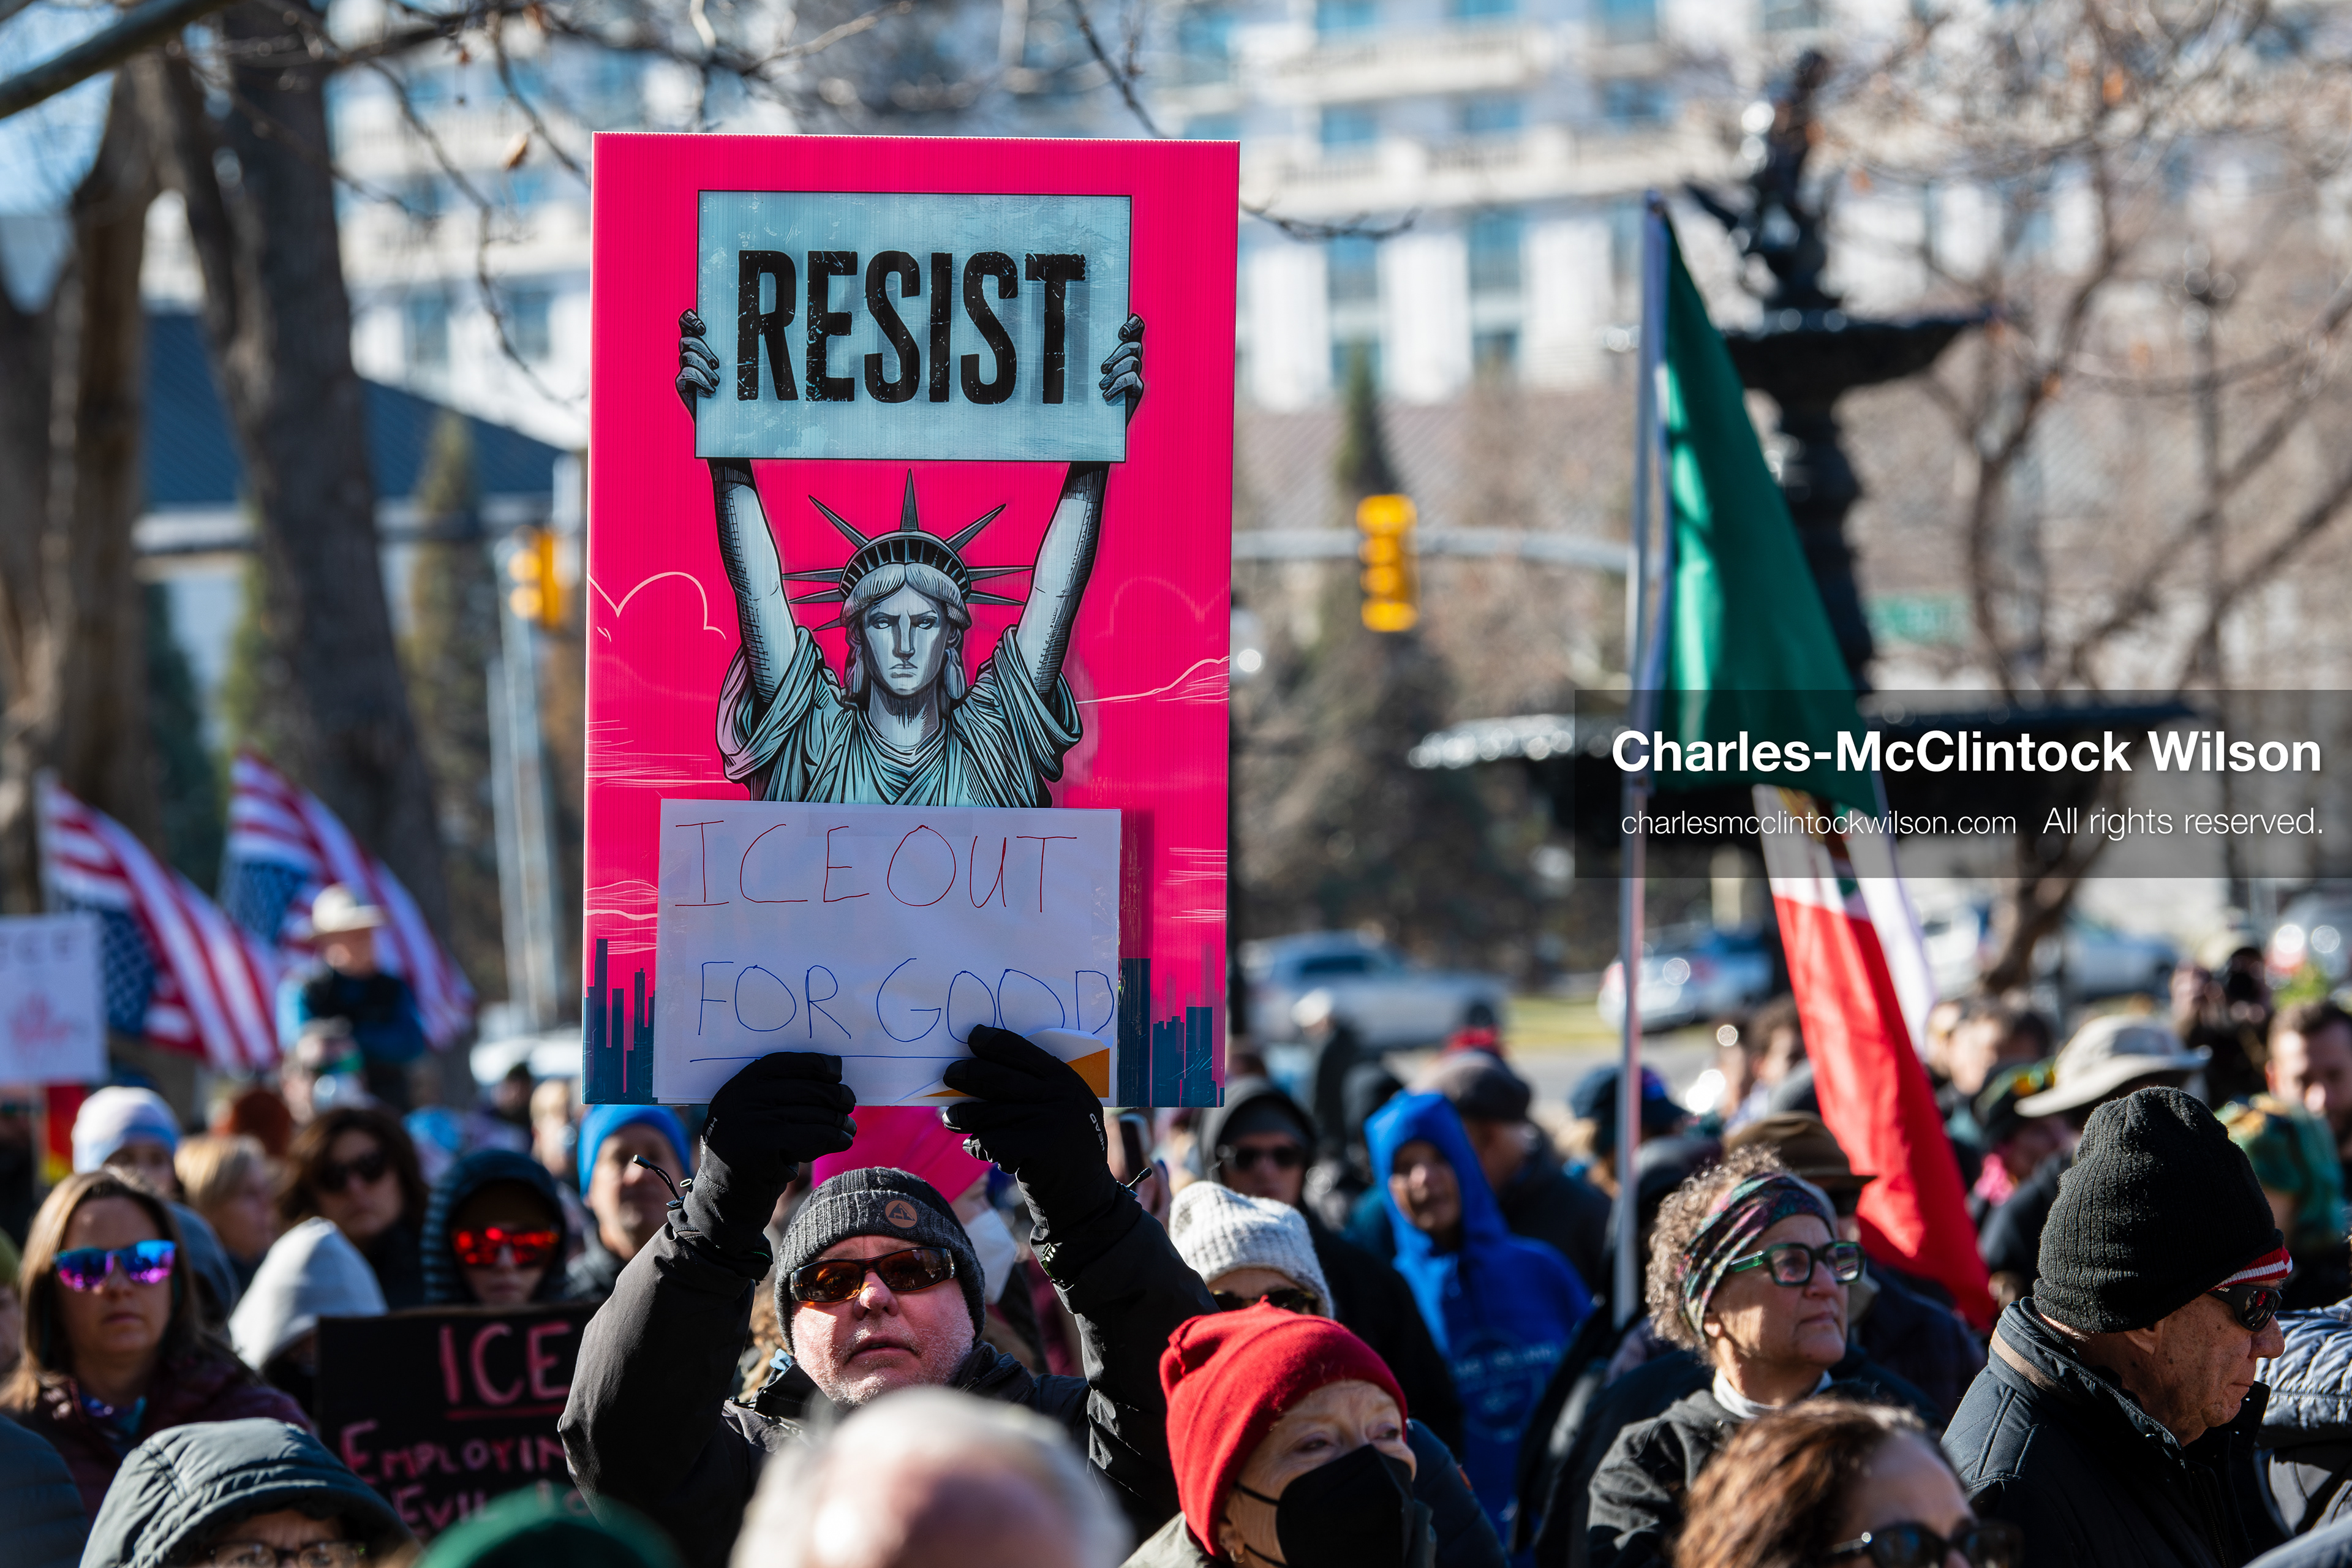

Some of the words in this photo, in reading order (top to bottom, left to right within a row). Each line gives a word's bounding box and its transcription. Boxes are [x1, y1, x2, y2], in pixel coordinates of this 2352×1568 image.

[737, 250, 1087, 405] RESIST
[698, 960, 851, 1040] FOR
[876, 957, 1115, 1044] GOOD
[439, 1321, 573, 1406] ICE
